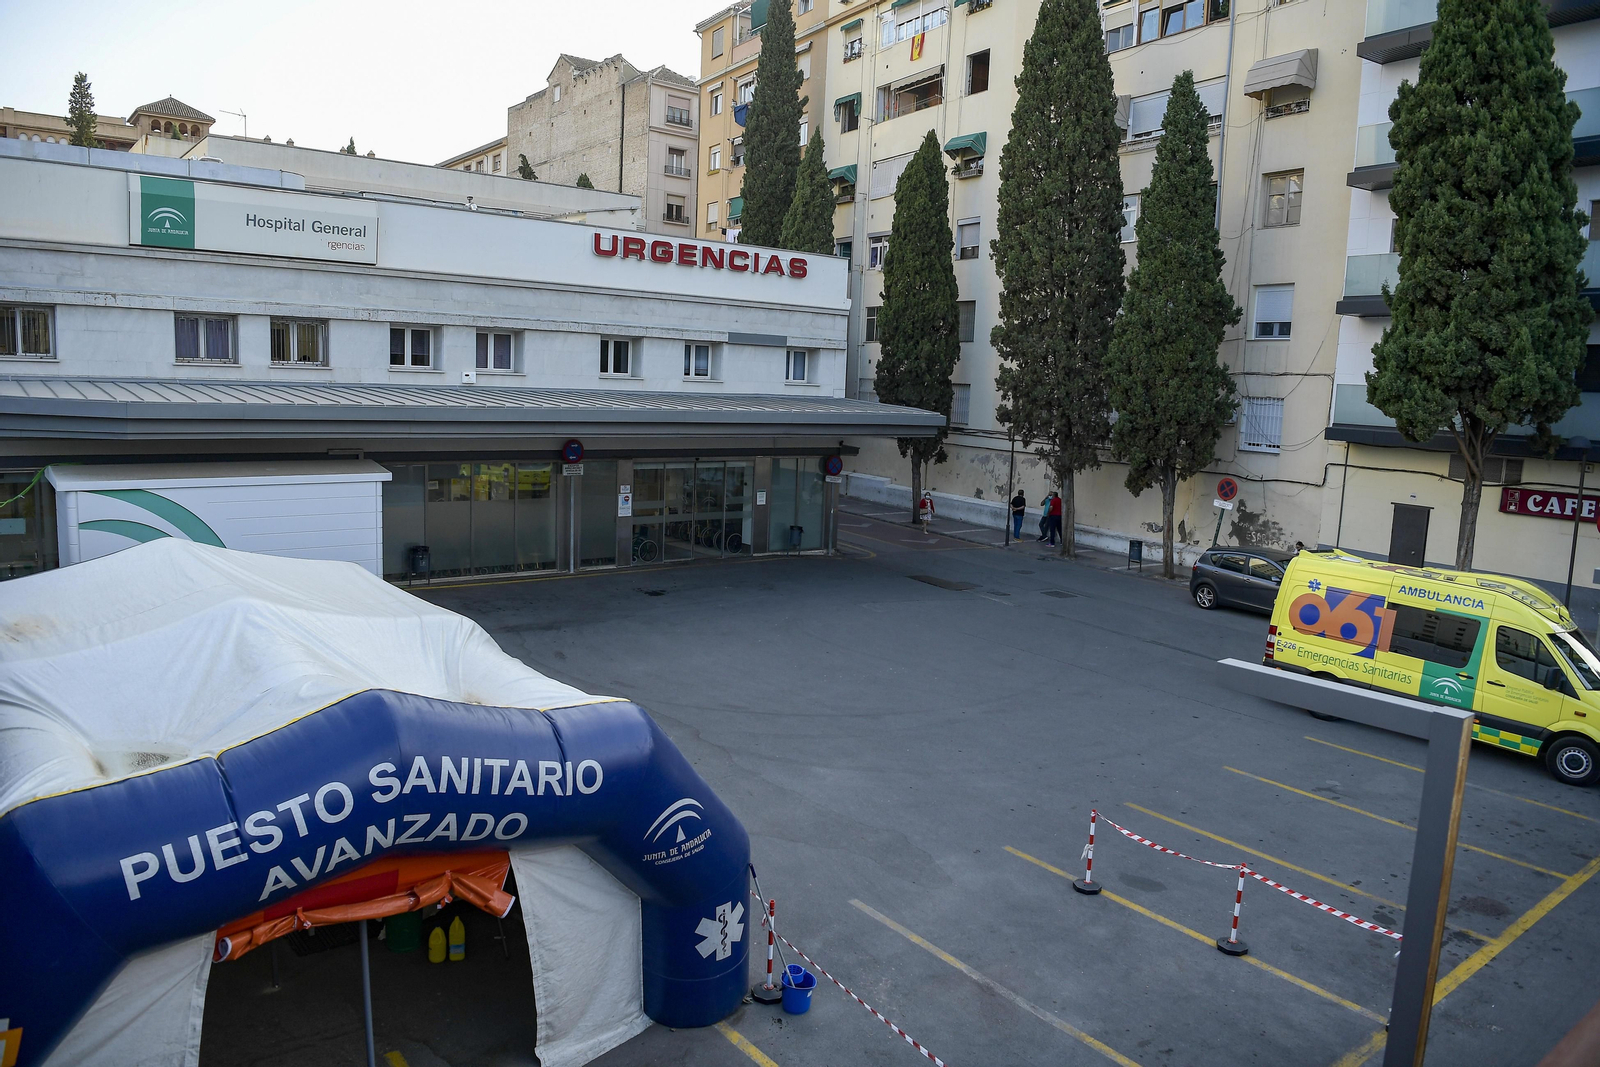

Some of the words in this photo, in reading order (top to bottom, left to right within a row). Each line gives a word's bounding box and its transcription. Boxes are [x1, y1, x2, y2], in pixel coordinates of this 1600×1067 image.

[246, 213, 305, 232] Hospital
[312, 220, 366, 237] General
[594, 232, 808, 279] URGENCIAS
[1527, 494, 1600, 518] CAFE
[1398, 585, 1485, 610] AMBULANCIA
[1289, 590, 1397, 653] 061
[1276, 639, 1297, 650] E-226
[1297, 646, 1360, 671] Emergencias
[1362, 662, 1412, 685] Sanitarias
[119, 781, 355, 901] PUESTO
[368, 755, 604, 804] SANITARIO
[643, 851, 667, 862] JUNTA
[670, 847, 679, 856] DE
[681, 828, 712, 852] ANDALUCIA
[258, 812, 529, 902] AVANZADO
